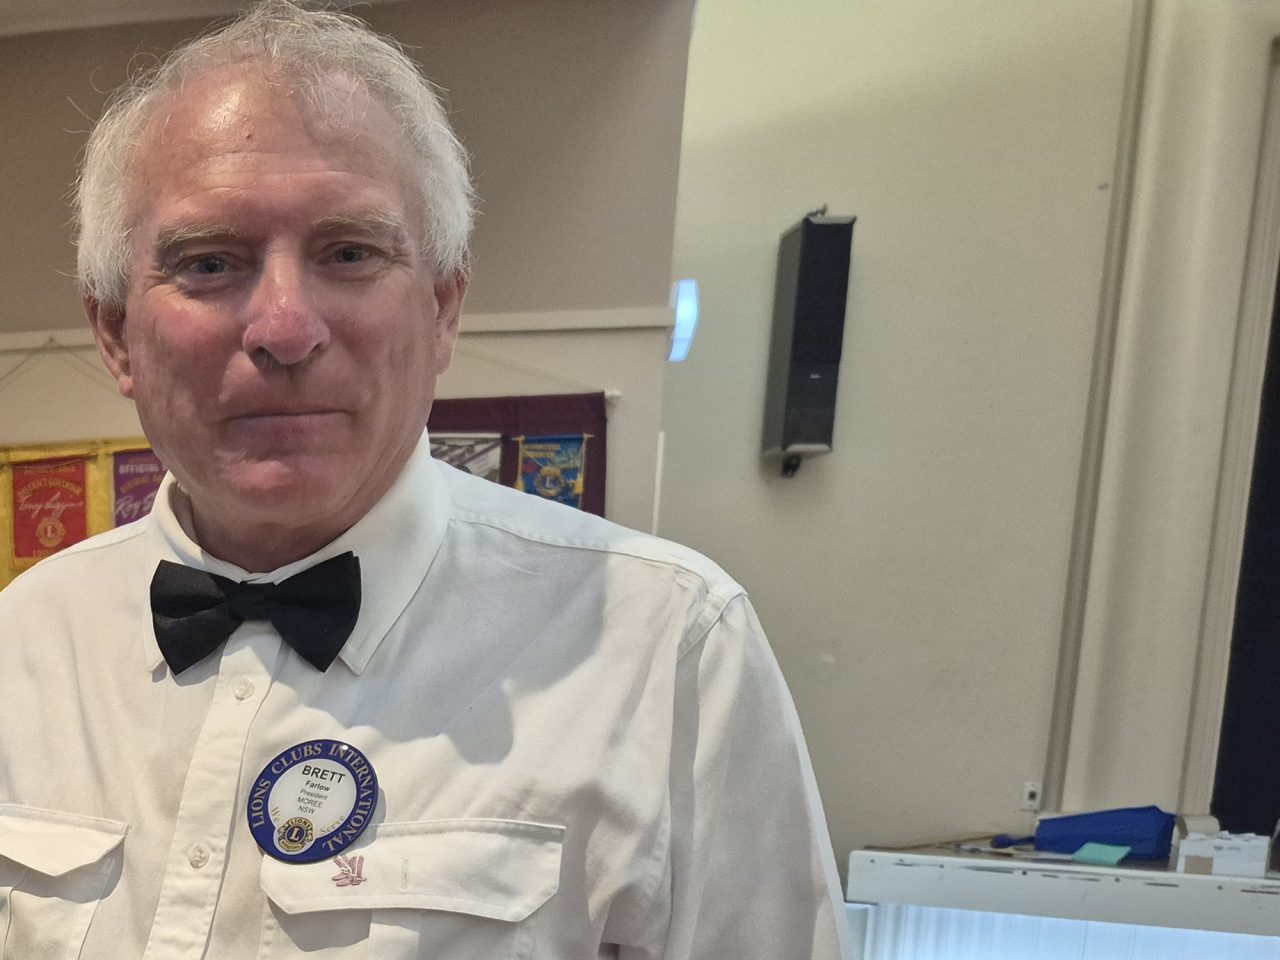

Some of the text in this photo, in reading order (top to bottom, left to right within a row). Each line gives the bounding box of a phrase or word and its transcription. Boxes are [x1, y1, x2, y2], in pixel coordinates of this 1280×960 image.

[302, 765, 346, 783] BRETT
[305, 780, 331, 792] Farlow
[251, 743, 373, 852] LIONS CLUBS INTERNATIONAL
[300, 788, 328, 800] President
[297, 796, 324, 808] MOREE
[298, 805, 316, 815] NSW
[290, 827, 300, 841] L
